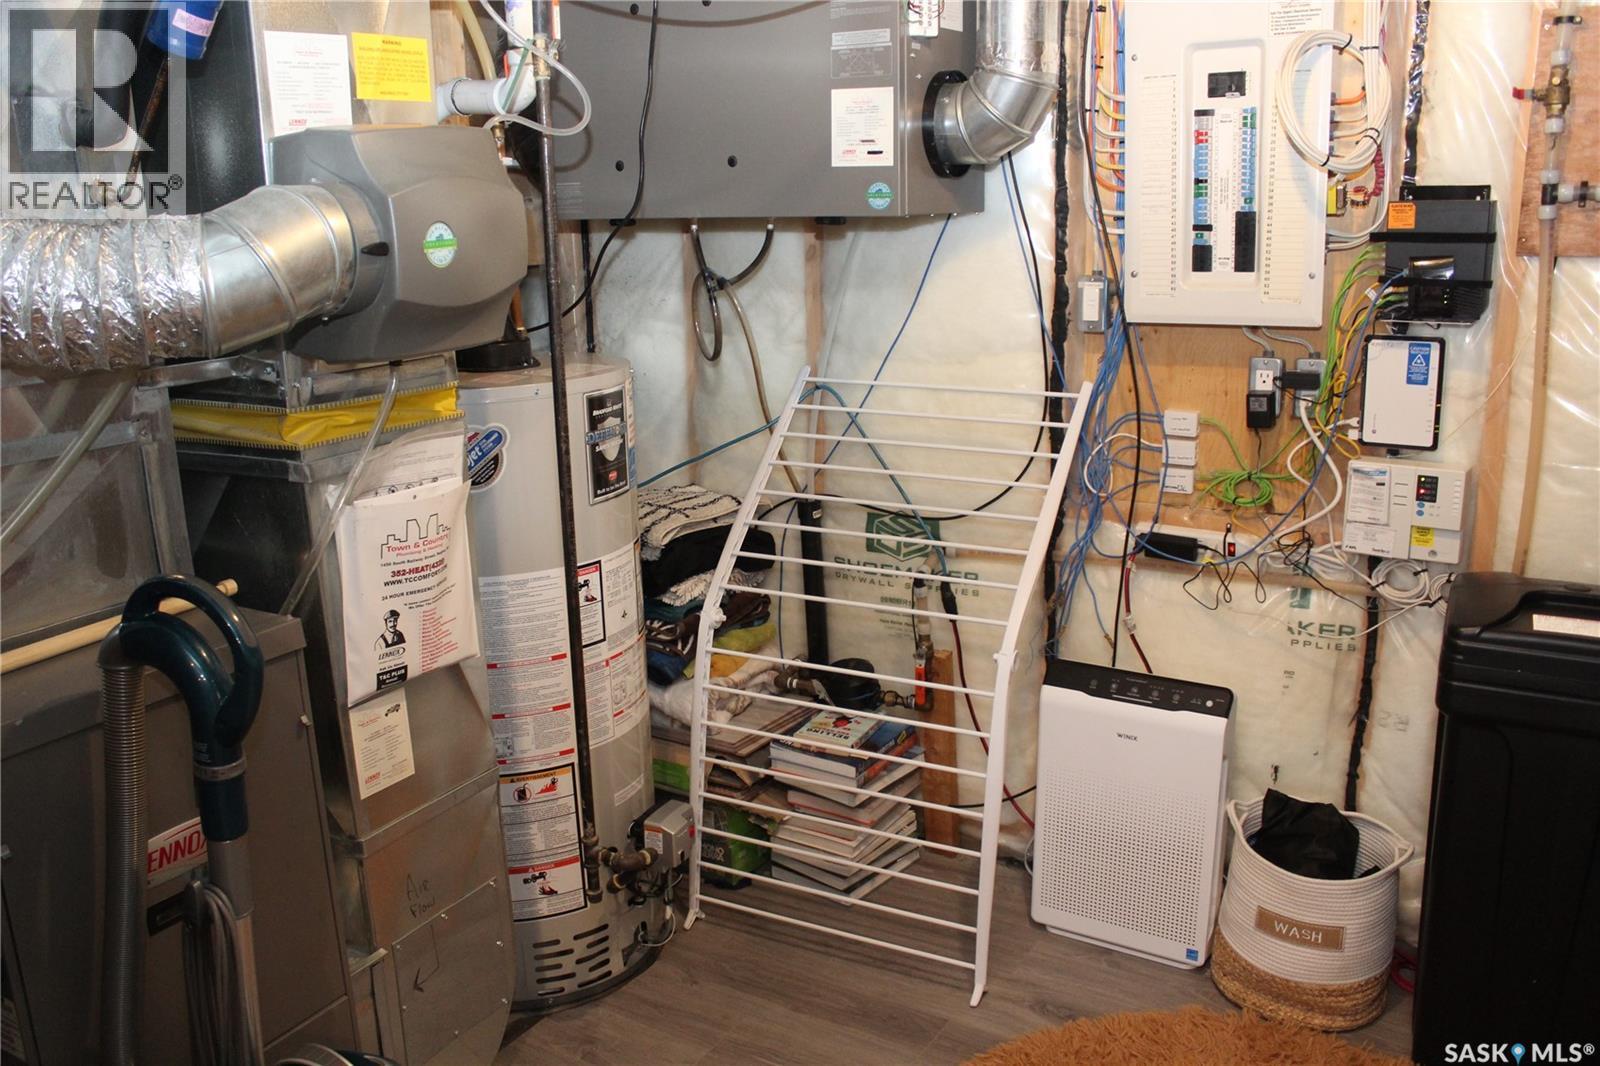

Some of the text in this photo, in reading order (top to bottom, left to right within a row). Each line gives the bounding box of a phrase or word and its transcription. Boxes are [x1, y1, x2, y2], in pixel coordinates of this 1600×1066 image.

[835, 571, 895, 587] DRYWALL
[1290, 639, 1357, 652] PPLIES
[391, 668, 405, 677] PLUS
[1116, 732, 1138, 742] WINIX
[147, 830, 208, 874] ENNO
[1274, 920, 1323, 944] WASH
